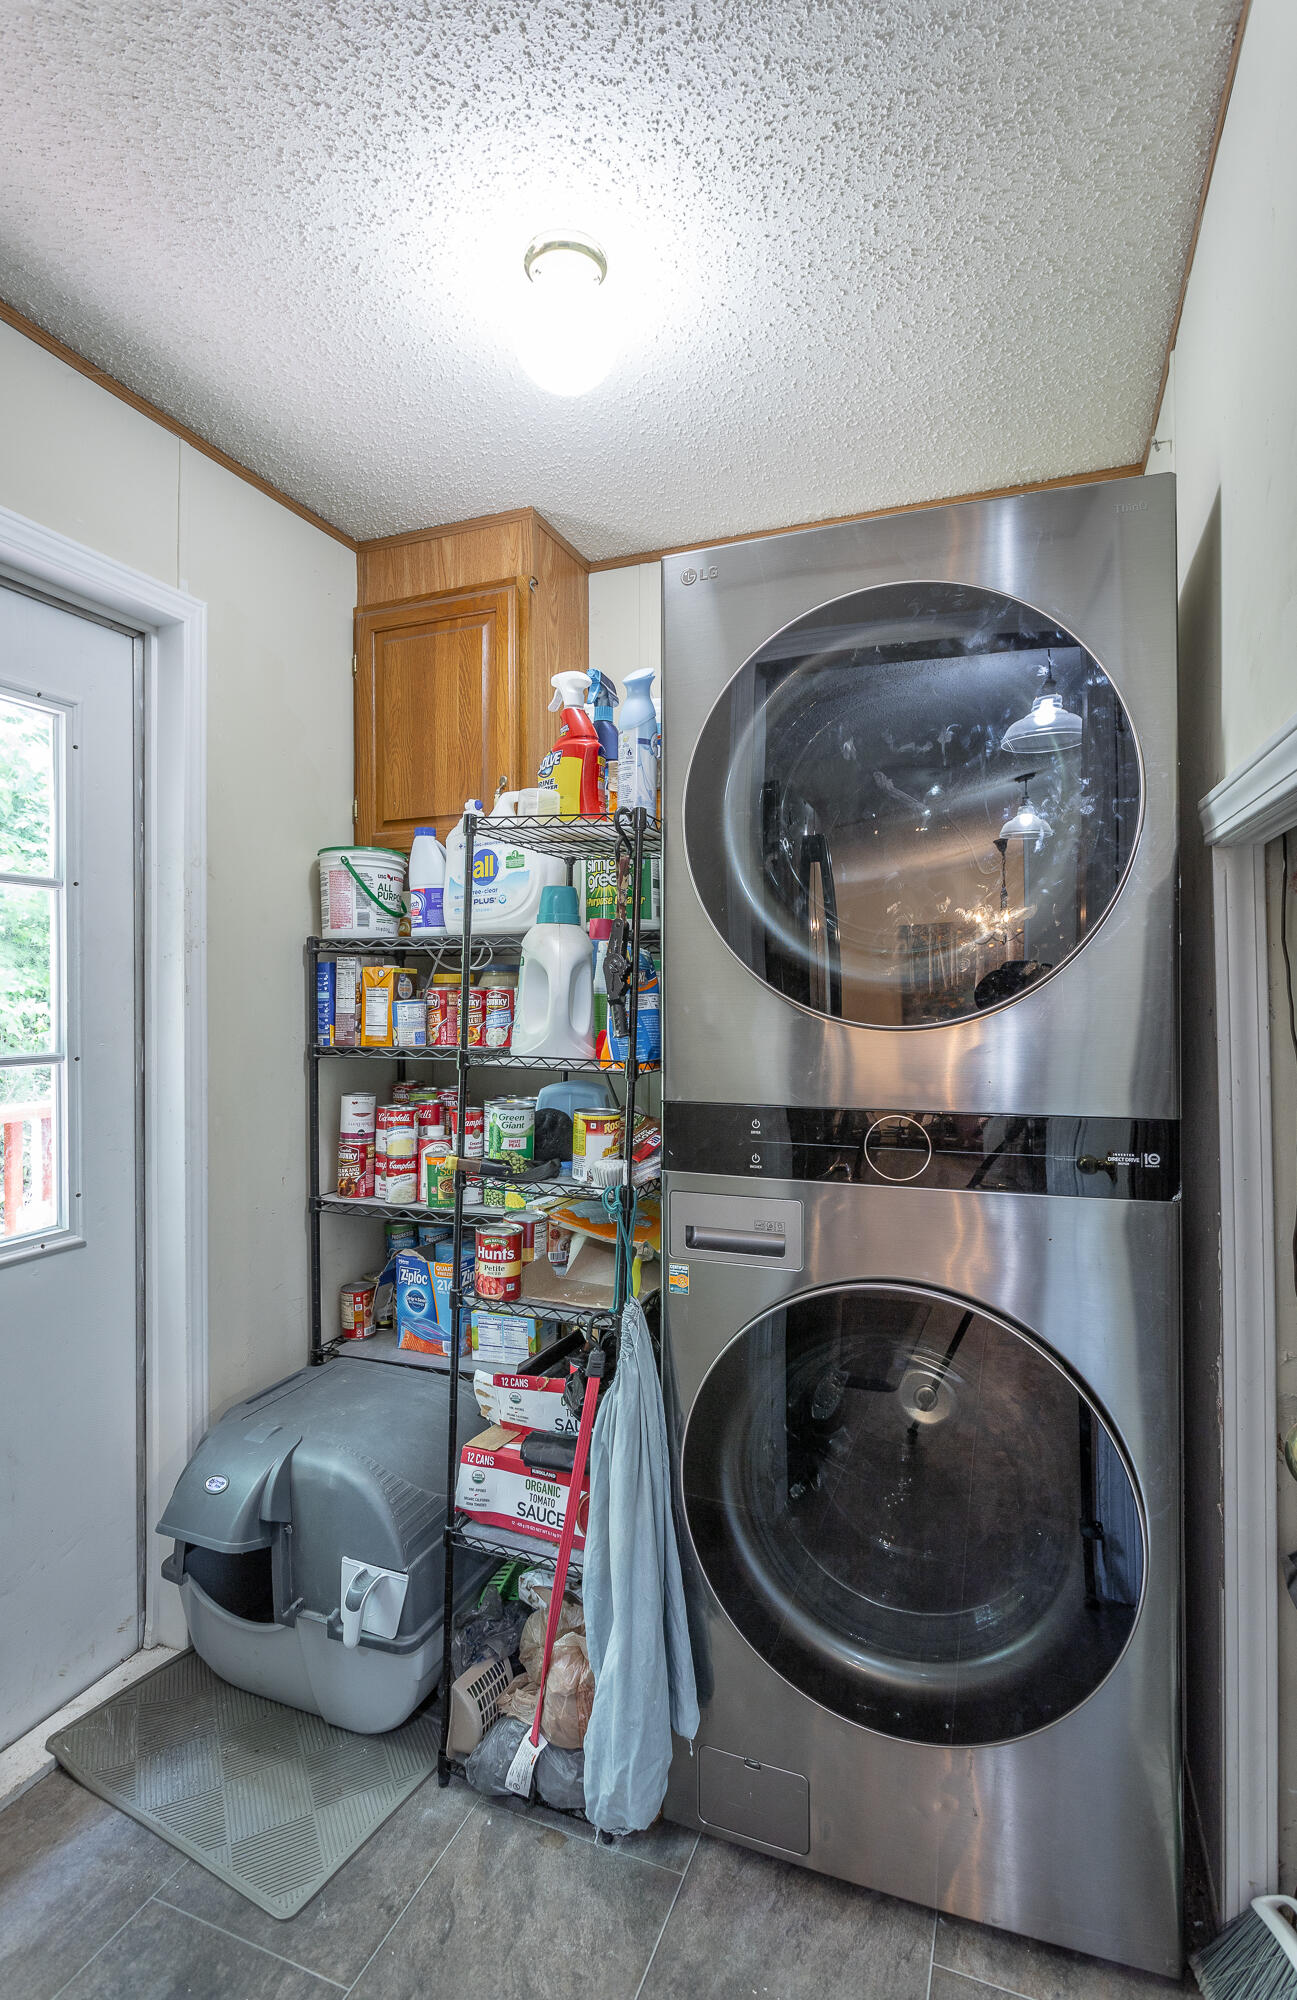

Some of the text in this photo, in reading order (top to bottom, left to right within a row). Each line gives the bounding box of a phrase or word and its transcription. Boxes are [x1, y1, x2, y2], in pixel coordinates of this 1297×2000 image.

[473, 855, 495, 879] all
[378, 883, 393, 892] ALL
[588, 872, 632, 893] gree
[498, 1113, 525, 1121] Green
[501, 1121, 525, 1129] Giant
[477, 1246, 515, 1260] Hunt's
[400, 1268, 428, 1286] Ziploc
[501, 1377, 529, 1388] 12 CANS
[467, 1451, 495, 1466] 12 CANS
[525, 1478, 561, 1498] ORGANIC
[529, 1492, 556, 1508] TOMATO
[516, 1501, 566, 1528] SAUCE
